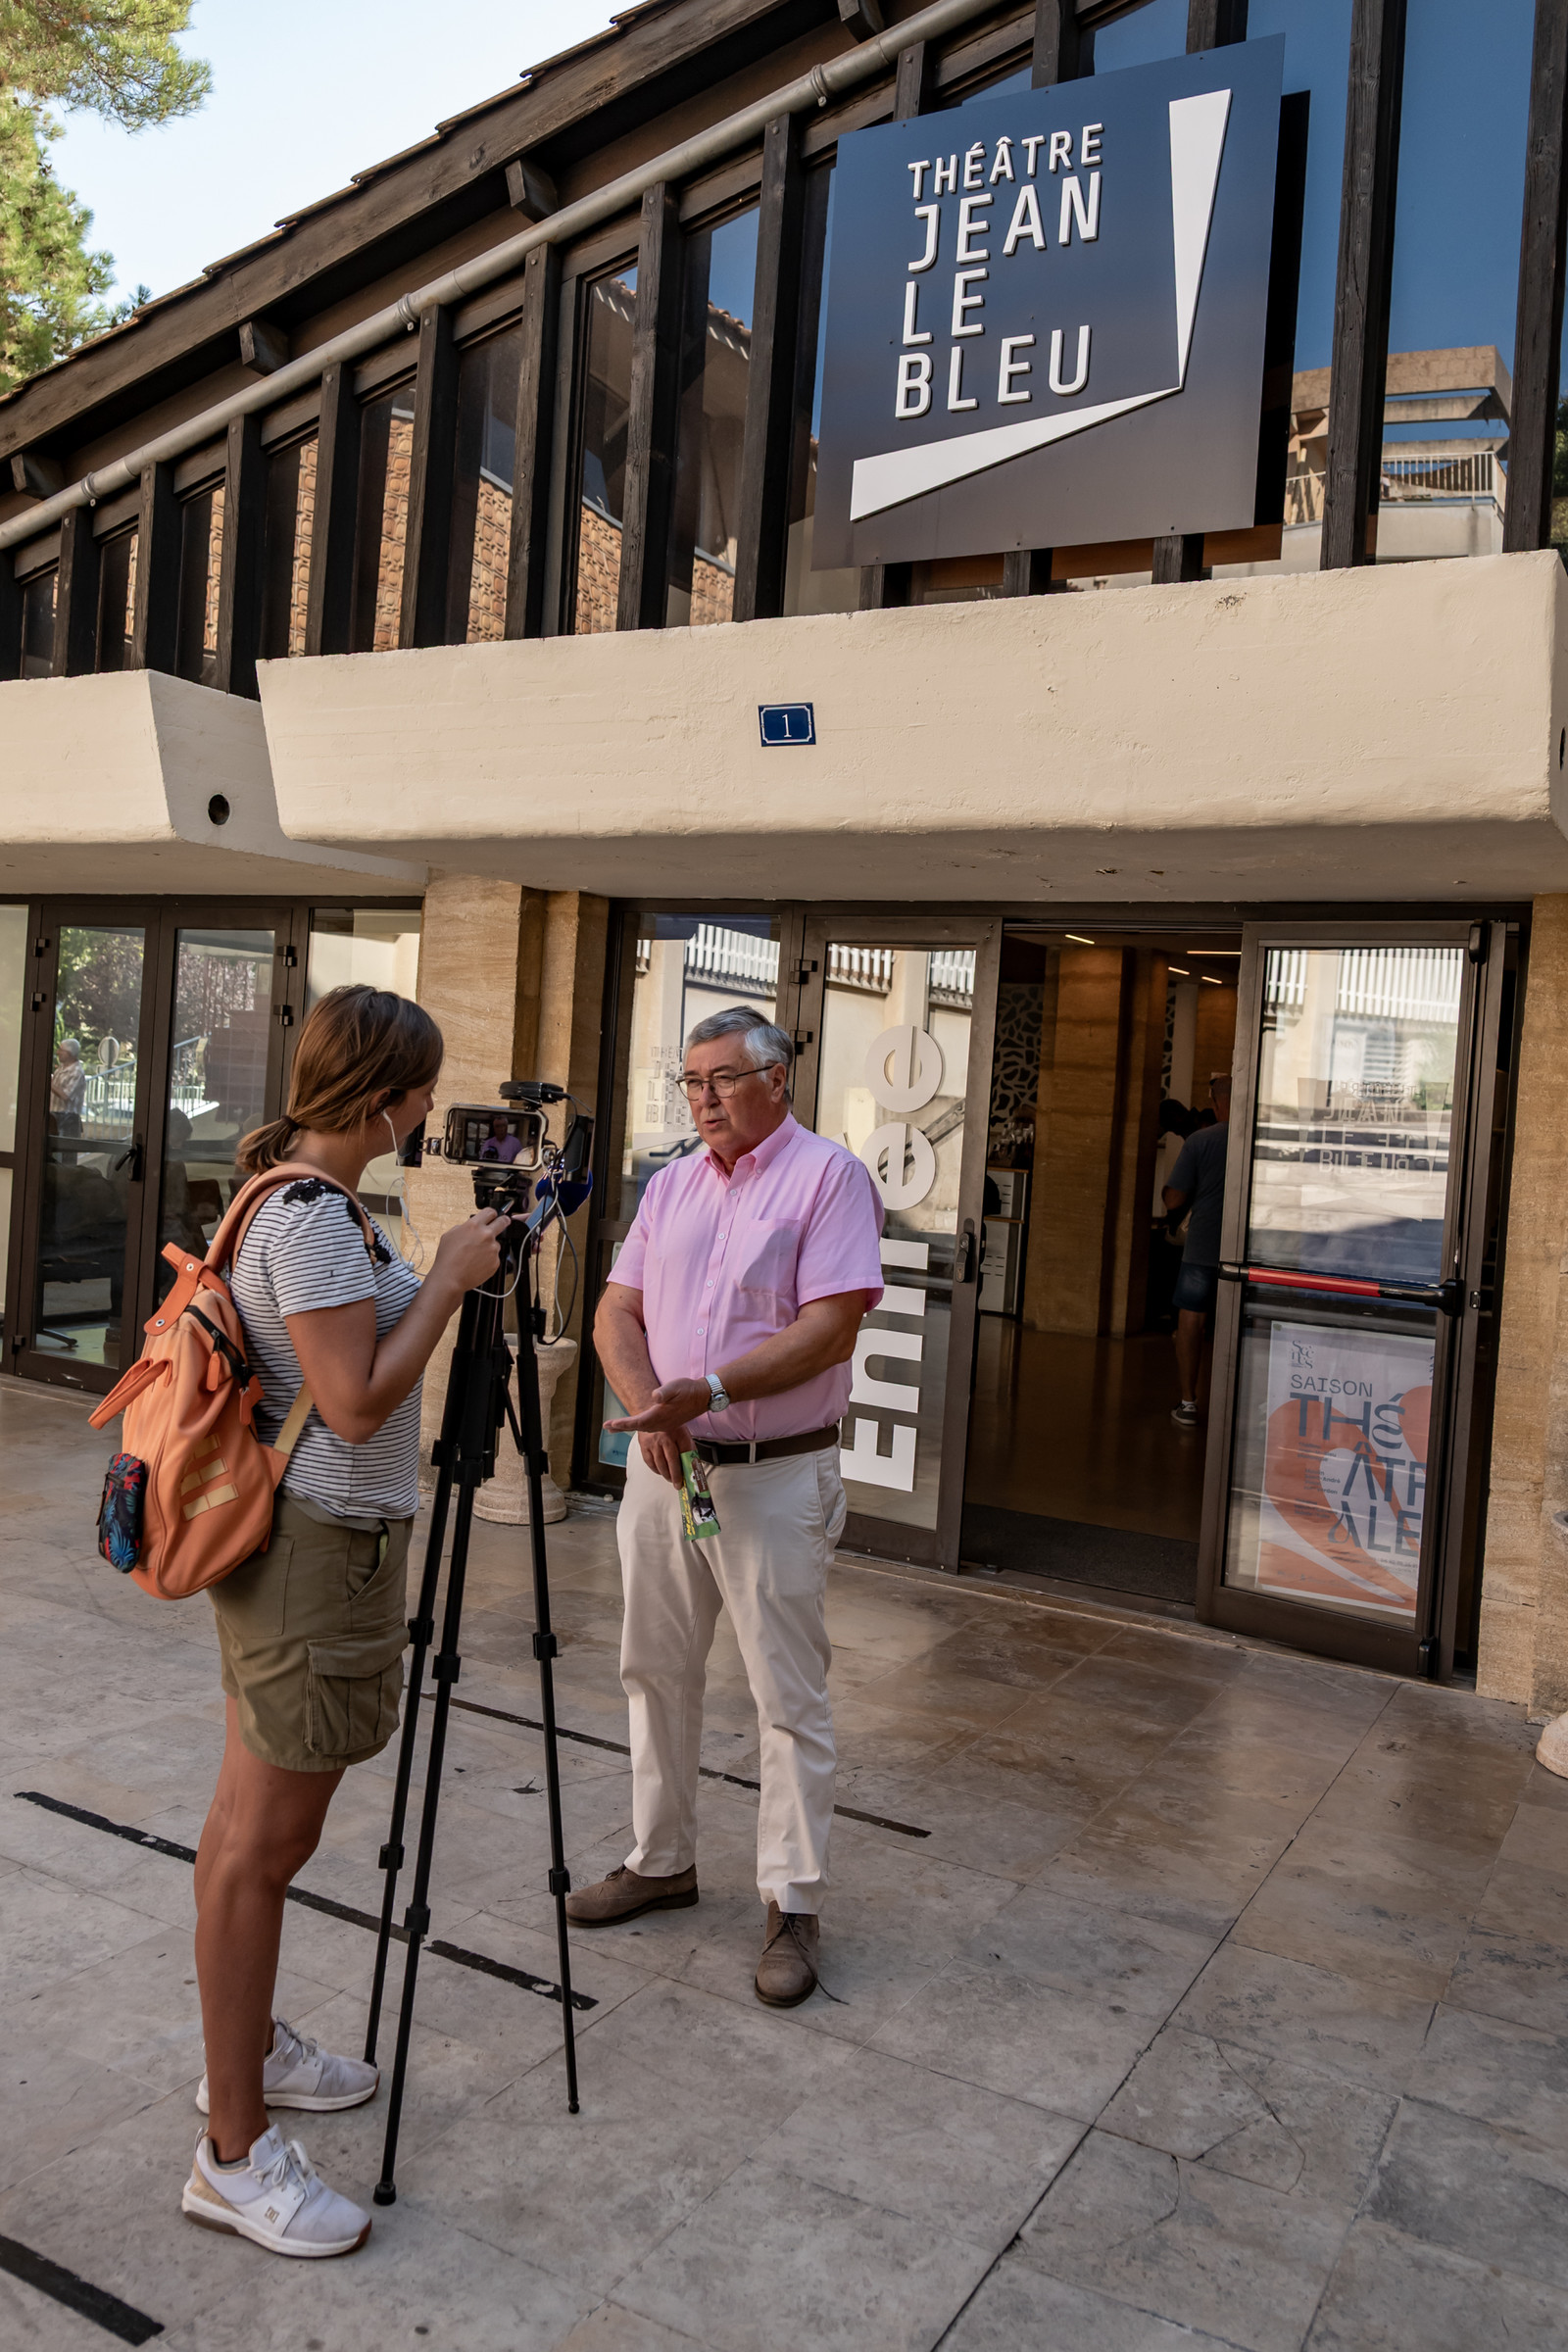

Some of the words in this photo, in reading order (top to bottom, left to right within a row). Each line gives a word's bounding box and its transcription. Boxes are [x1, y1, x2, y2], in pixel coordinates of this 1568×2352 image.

[907, 122, 1103, 199] THÉÂTRE
[907, 172, 1102, 273] JEAN
[902, 268, 988, 347] LE
[895, 325, 1092, 419] BLEU
[782, 713, 792, 737] 1
[1290, 1374, 1372, 1397] SAISON
